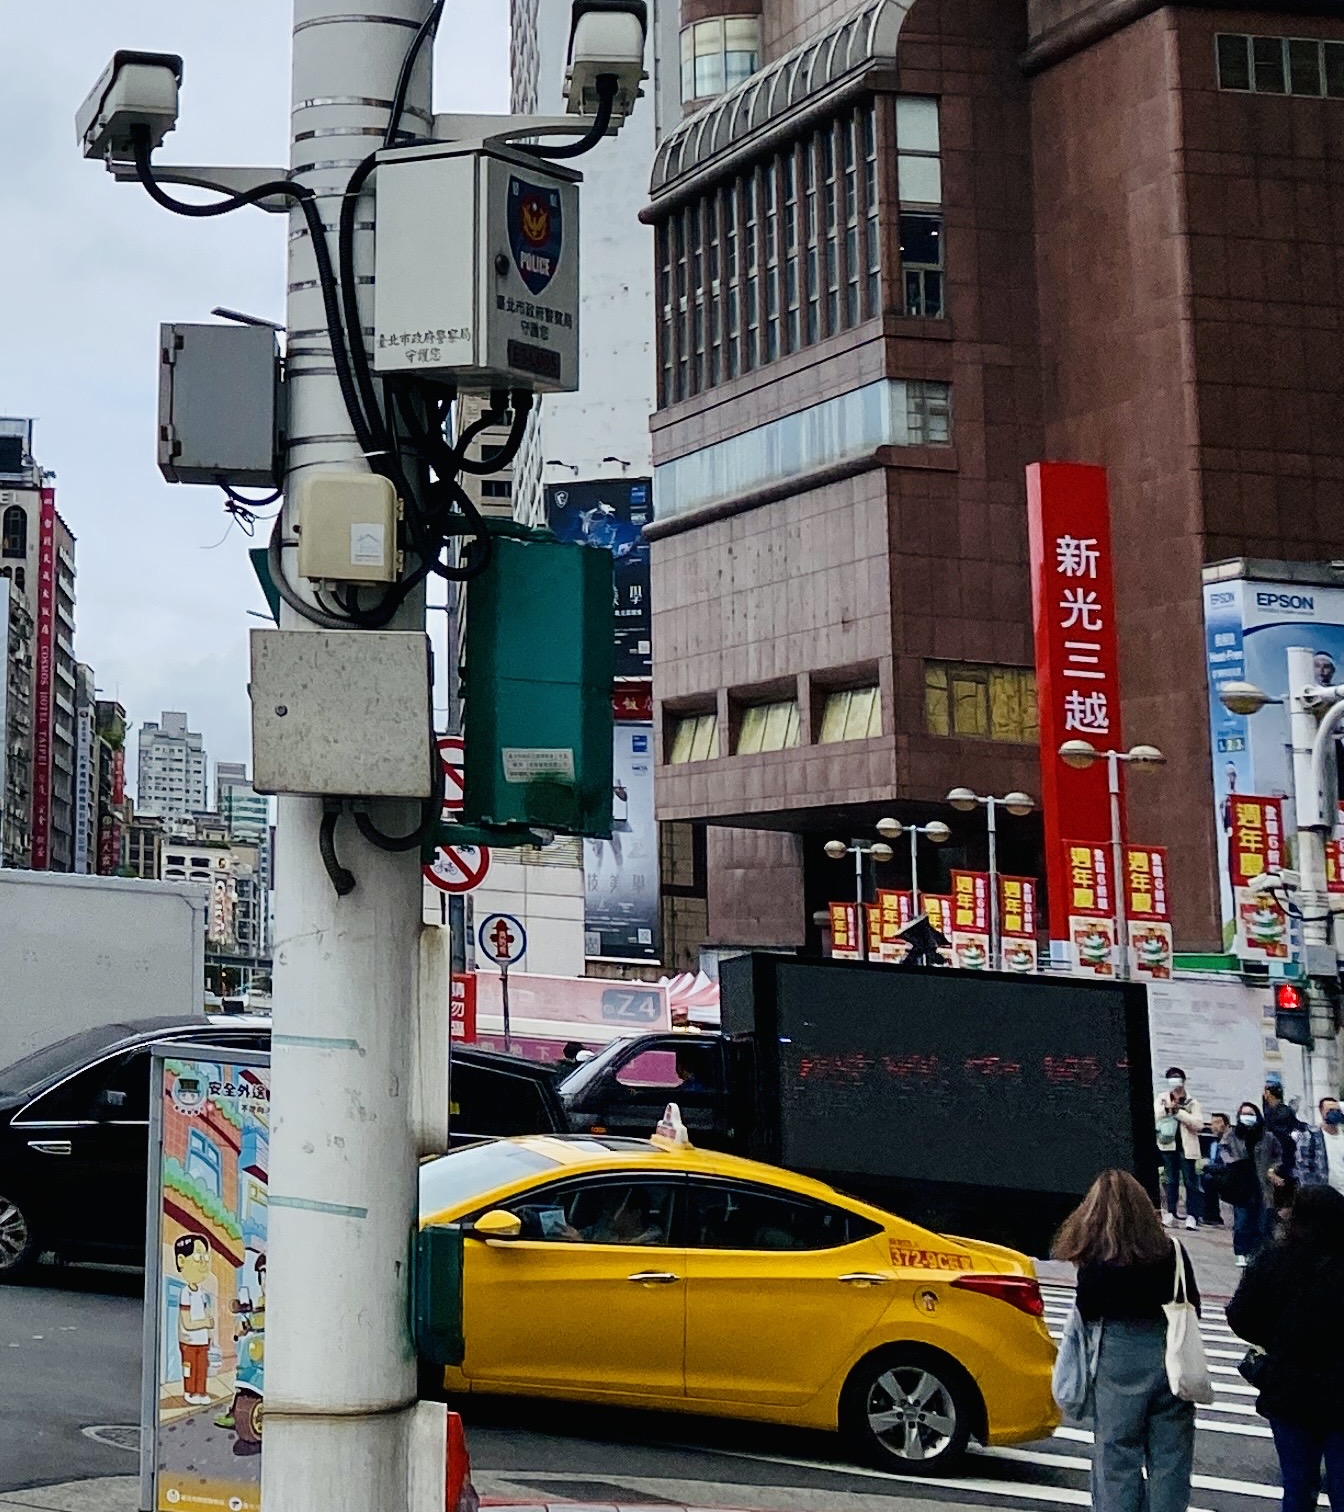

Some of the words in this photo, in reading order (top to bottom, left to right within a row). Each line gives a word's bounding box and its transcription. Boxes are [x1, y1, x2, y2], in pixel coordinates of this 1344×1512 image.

[520, 251, 551, 276] POLICE
[1210, 593, 1234, 606] EPSON
[1257, 592, 1314, 610] EPSON
[1056, 535, 1109, 734] 新光三越
[40, 645, 50, 685] COSMOS
[617, 993, 656, 1018] Z4
